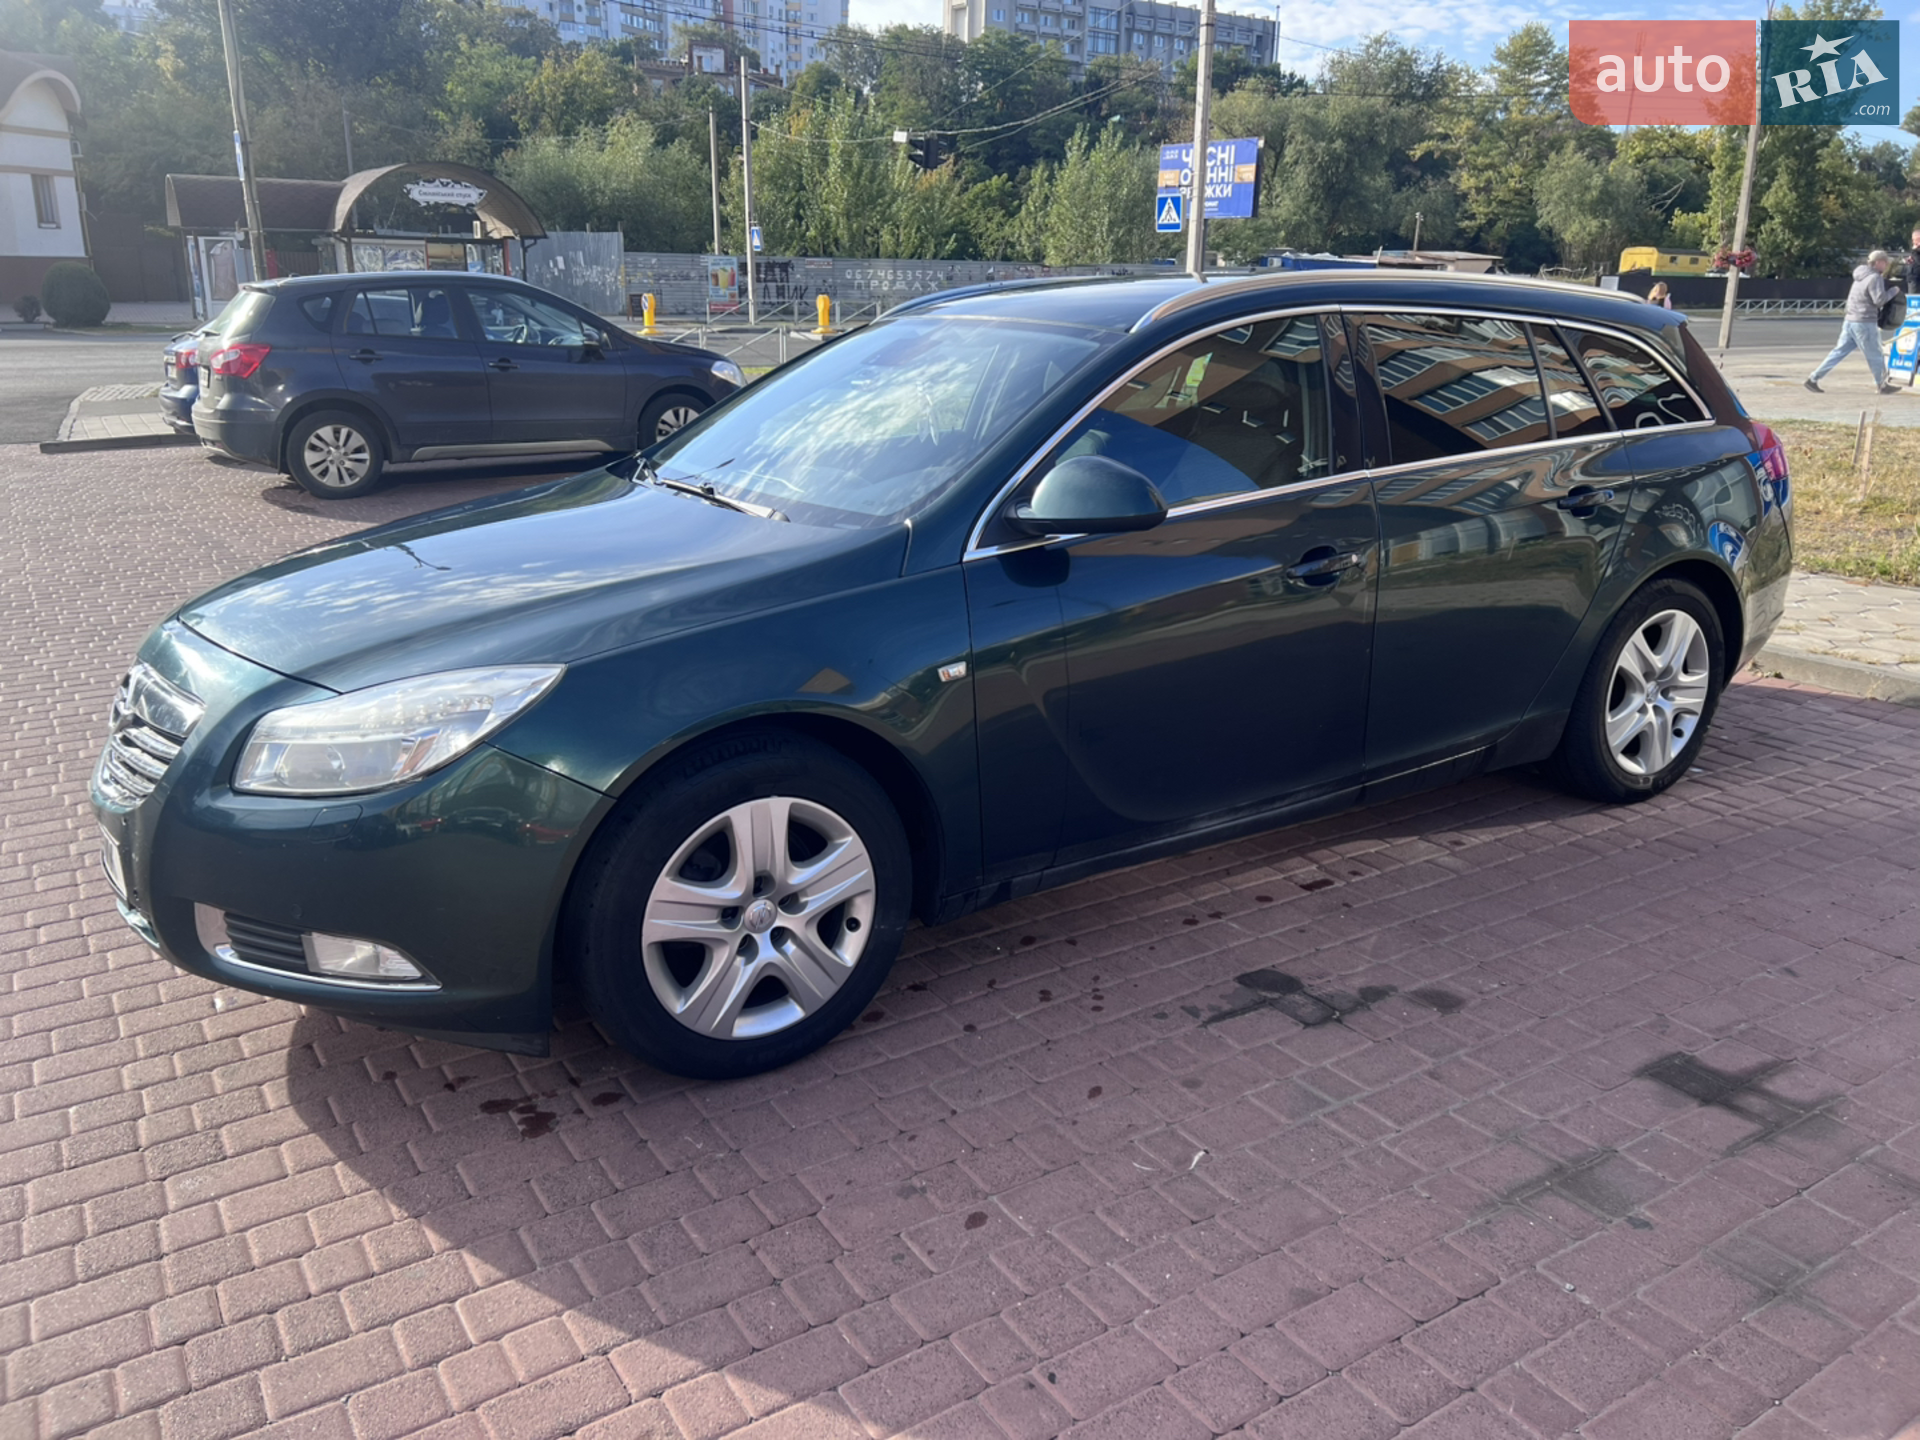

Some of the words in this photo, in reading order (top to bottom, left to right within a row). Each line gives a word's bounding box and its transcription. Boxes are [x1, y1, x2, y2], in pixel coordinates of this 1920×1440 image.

[1181, 145, 1235, 169] ЧСНІ
[845, 268, 944, 281] 0674653574
[854, 279, 940, 292] ПРОДАЖ
